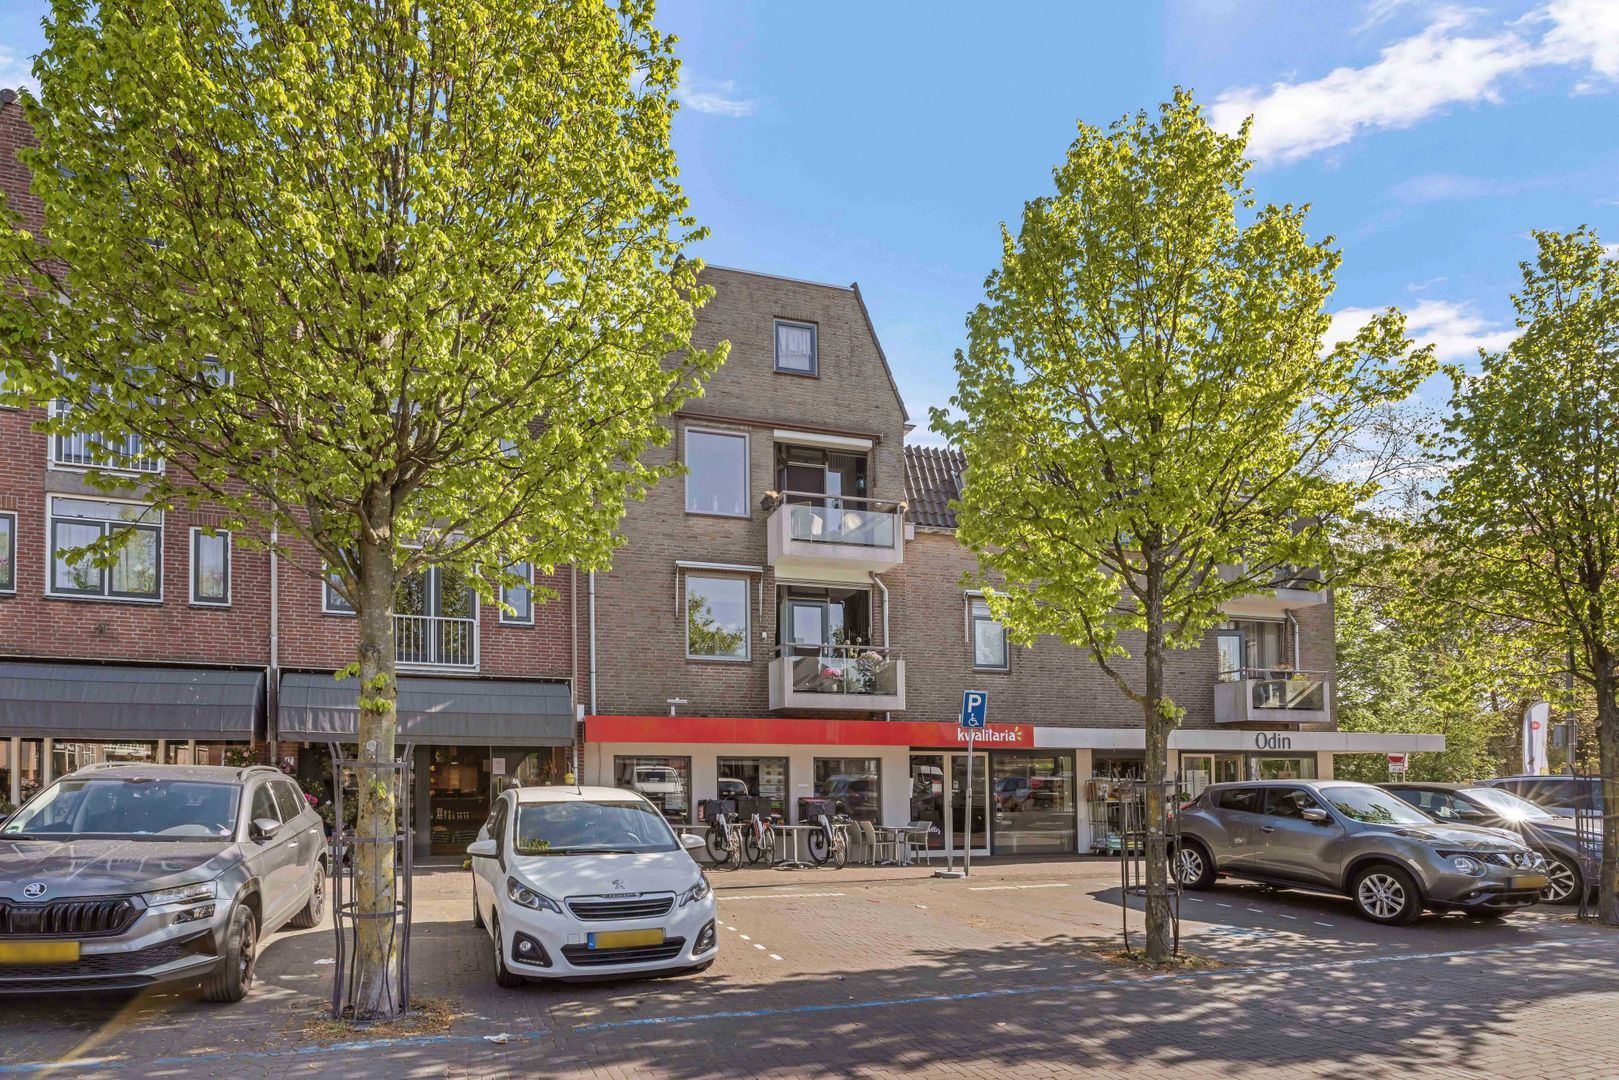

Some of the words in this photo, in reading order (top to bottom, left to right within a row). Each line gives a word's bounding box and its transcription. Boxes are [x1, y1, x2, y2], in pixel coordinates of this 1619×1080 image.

[968, 694, 982, 713] P
[957, 727, 1016, 742] kwalitaria
[1255, 732, 1291, 750] Odin
